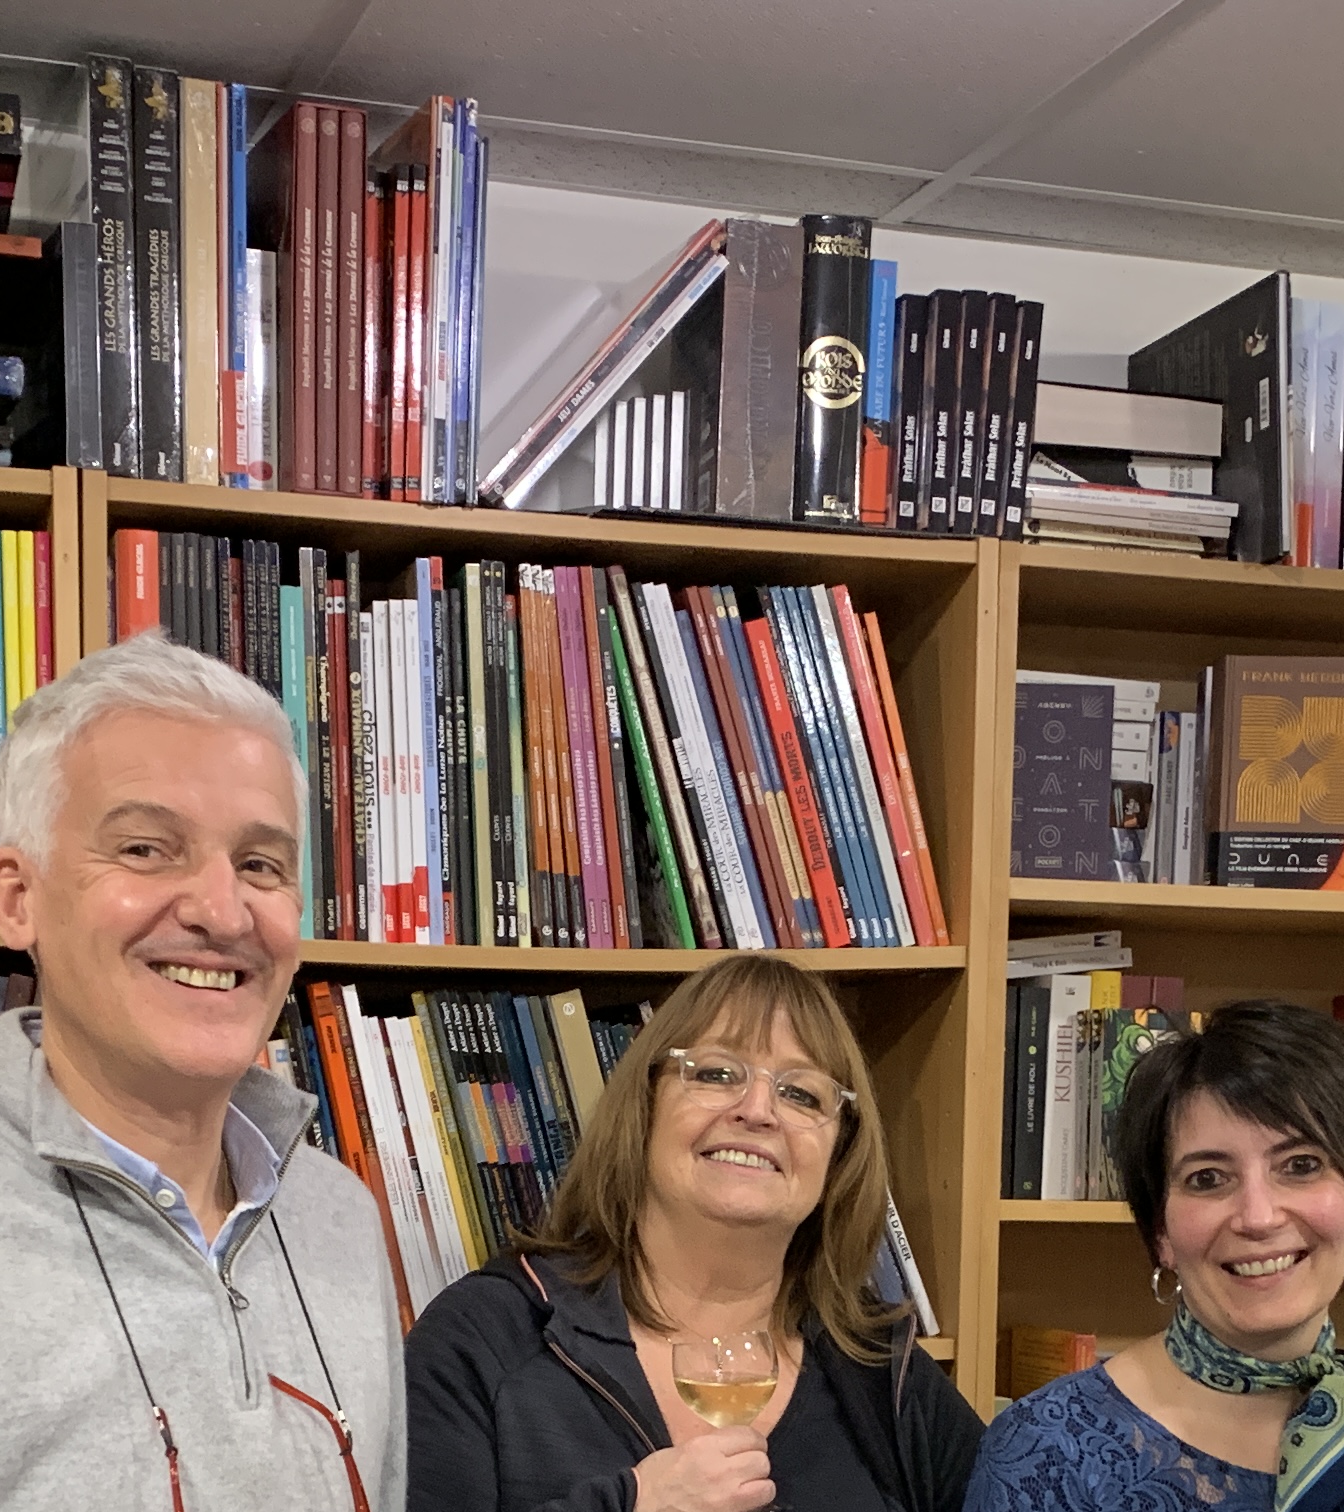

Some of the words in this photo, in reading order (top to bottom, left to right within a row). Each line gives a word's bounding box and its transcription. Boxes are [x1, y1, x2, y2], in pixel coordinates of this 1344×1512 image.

[99, 217, 115, 264] HÉROS
[146, 228, 160, 289] TRAGÉDIES
[103, 267, 116, 328] GRANDS
[149, 290, 160, 343] GRANDES
[105, 330, 117, 352] LES
[150, 343, 161, 361] LES
[1242, 670, 1293, 683] FRANK
[605, 685, 622, 734] CONQUÊTES
[780, 730, 805, 783] MORTS
[794, 786, 812, 815] LES
[802, 816, 826, 872] DEBOUT
[1054, 1022, 1073, 1103] KUSHIEL
[891, 1219, 912, 1262] D'ACIER
